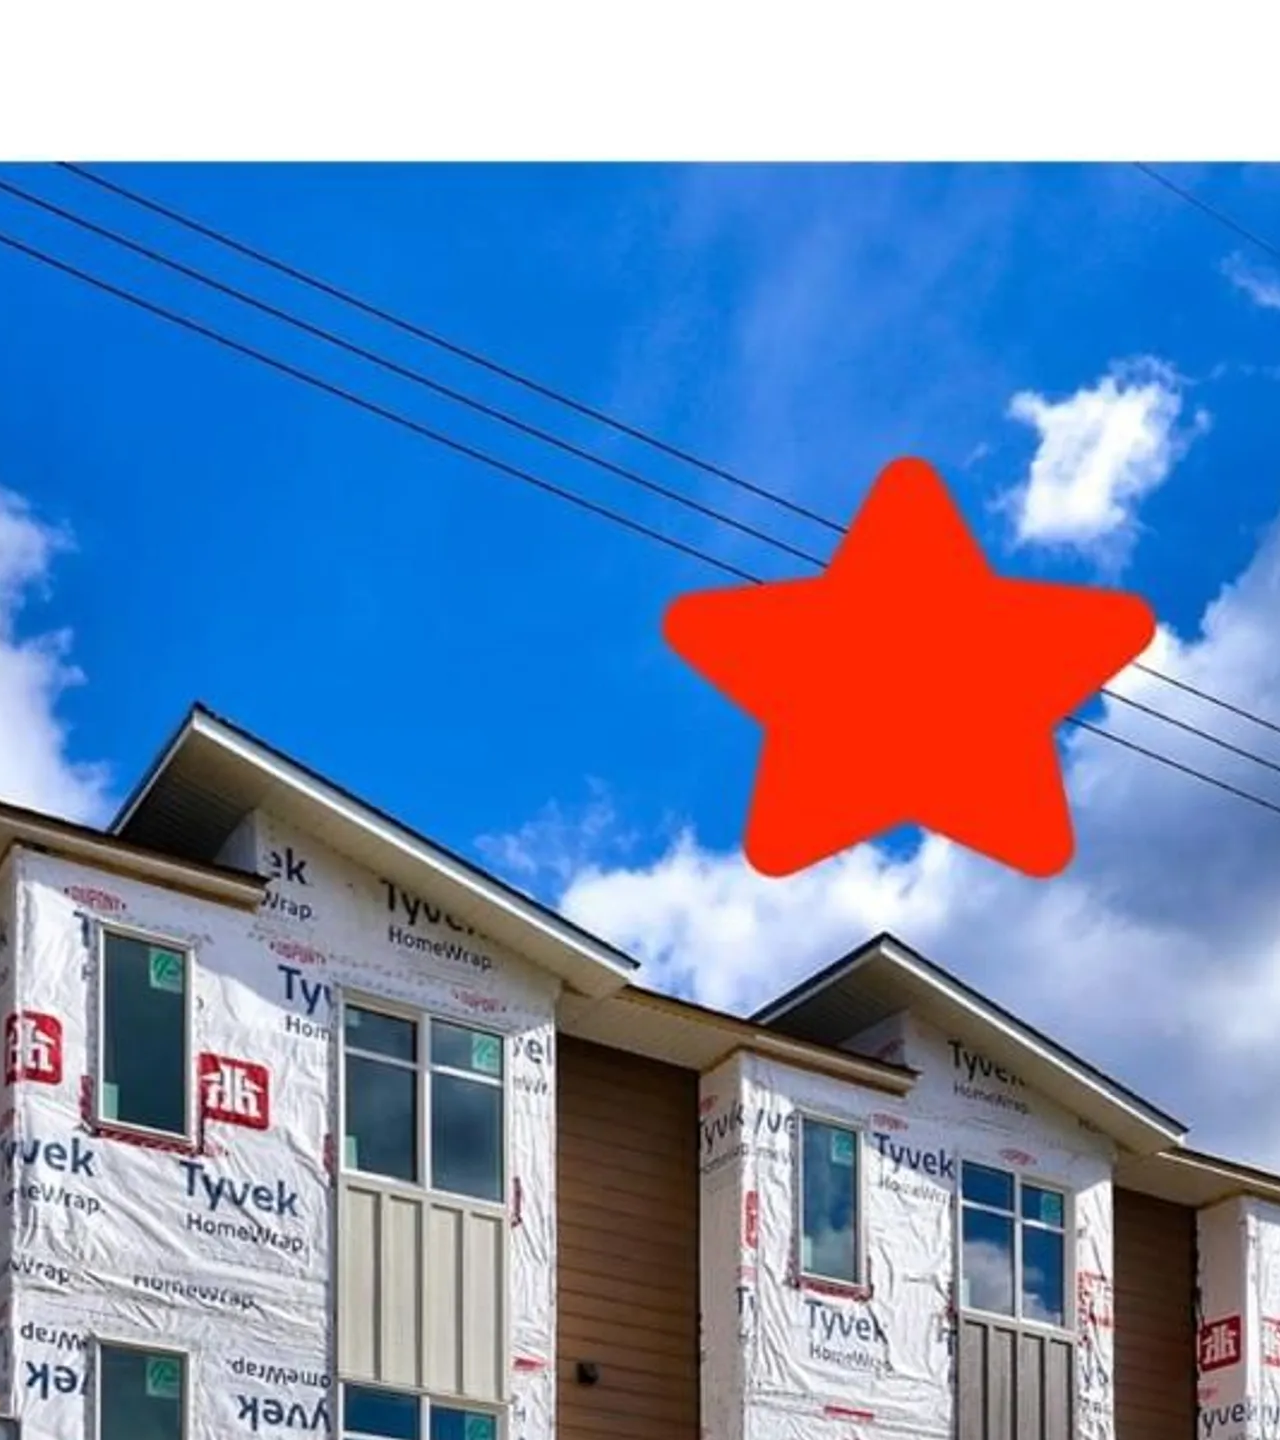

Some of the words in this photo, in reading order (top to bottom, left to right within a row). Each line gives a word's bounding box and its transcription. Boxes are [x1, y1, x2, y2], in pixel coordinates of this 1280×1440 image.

[388, 926, 493, 971] HomeWrap
[873, 1133, 956, 1181] Tyvek
[179, 1160, 298, 1216] Tyvek
[186, 1213, 303, 1252] HomeWrap
